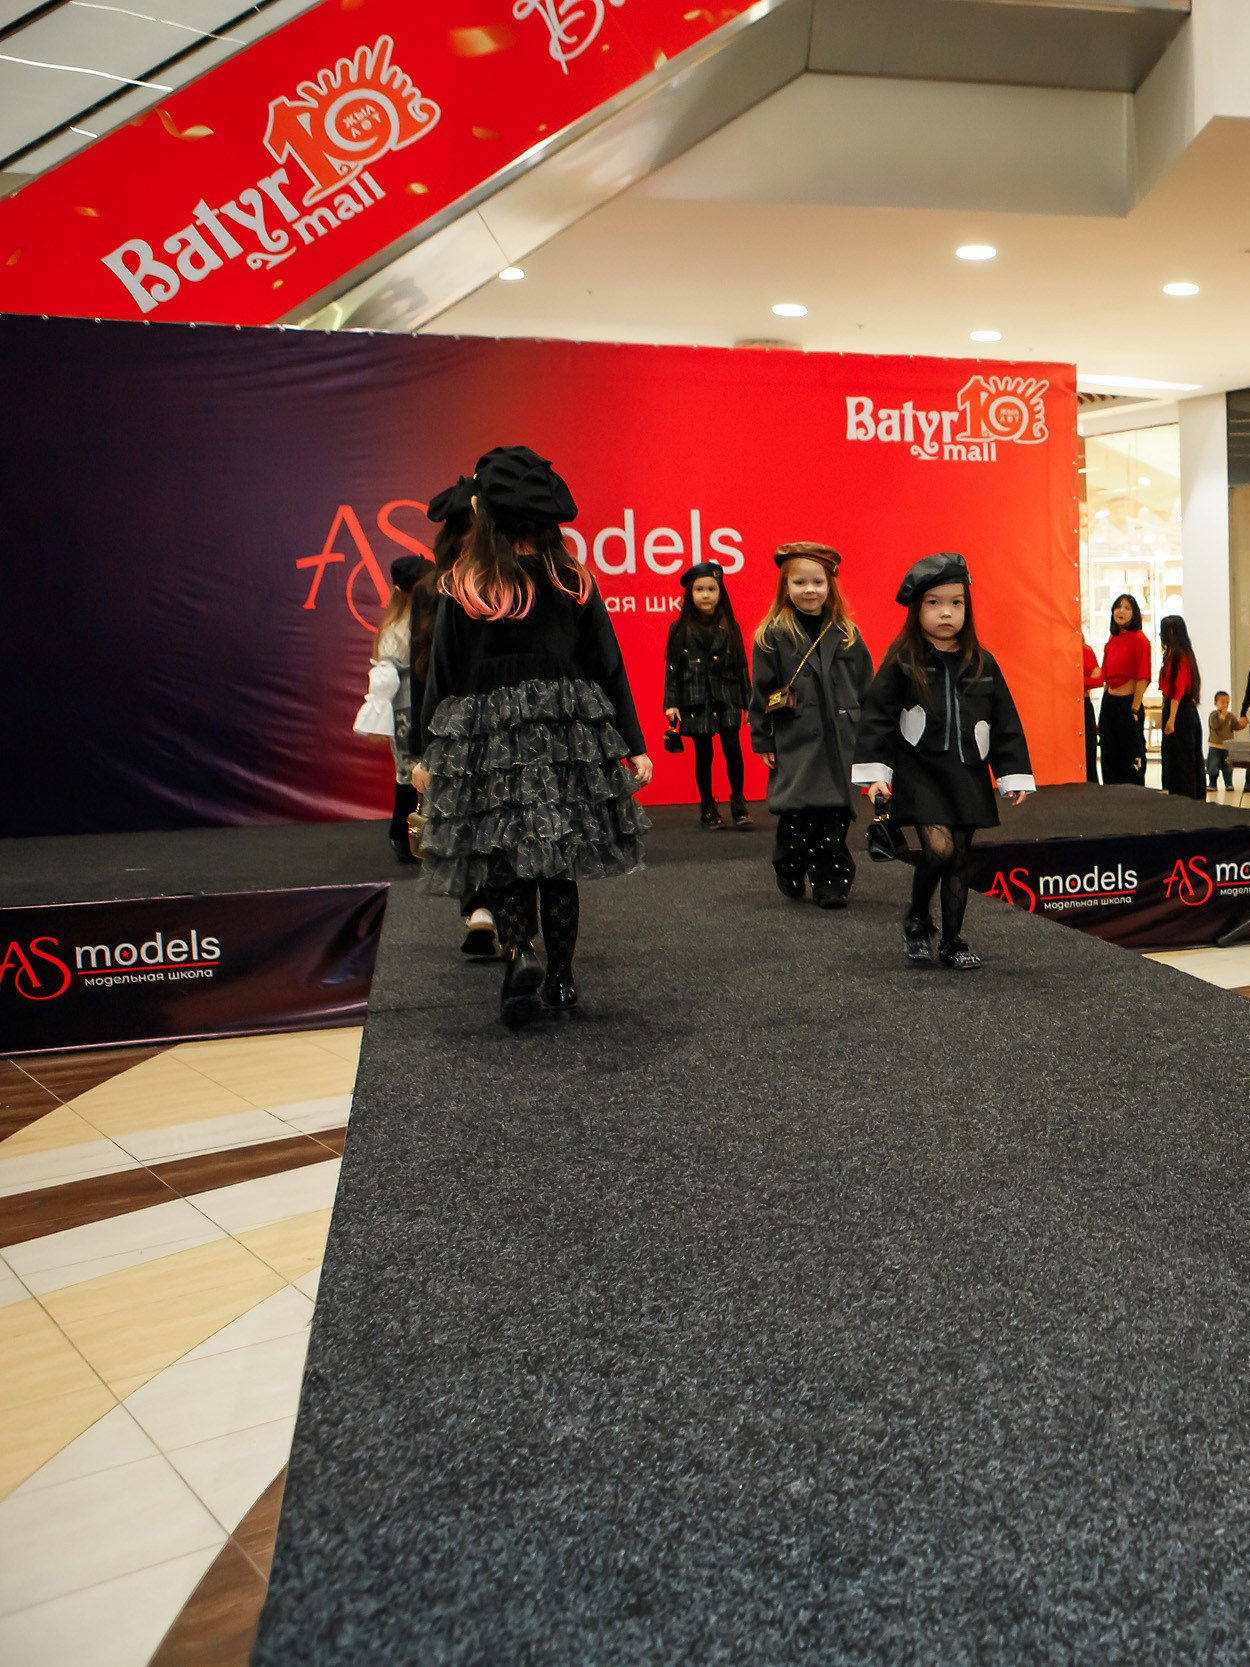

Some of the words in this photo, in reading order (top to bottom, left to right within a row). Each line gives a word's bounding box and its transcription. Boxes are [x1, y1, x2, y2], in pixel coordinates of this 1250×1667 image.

[292, 171, 386, 245] mall
[101, 168, 300, 313] Batyr
[846, 396, 959, 458] Batyr
[943, 442, 997, 461] mall
[1040, 863, 1138, 896] models
[1044, 899, 1098, 910] модельная
[1101, 896, 1132, 906] школа
[1163, 856, 1213, 906] AS
[0, 936, 71, 1000] AS
[75, 929, 221, 969] models
[84, 972, 165, 987] модельная
[168, 968, 213, 981] школа
